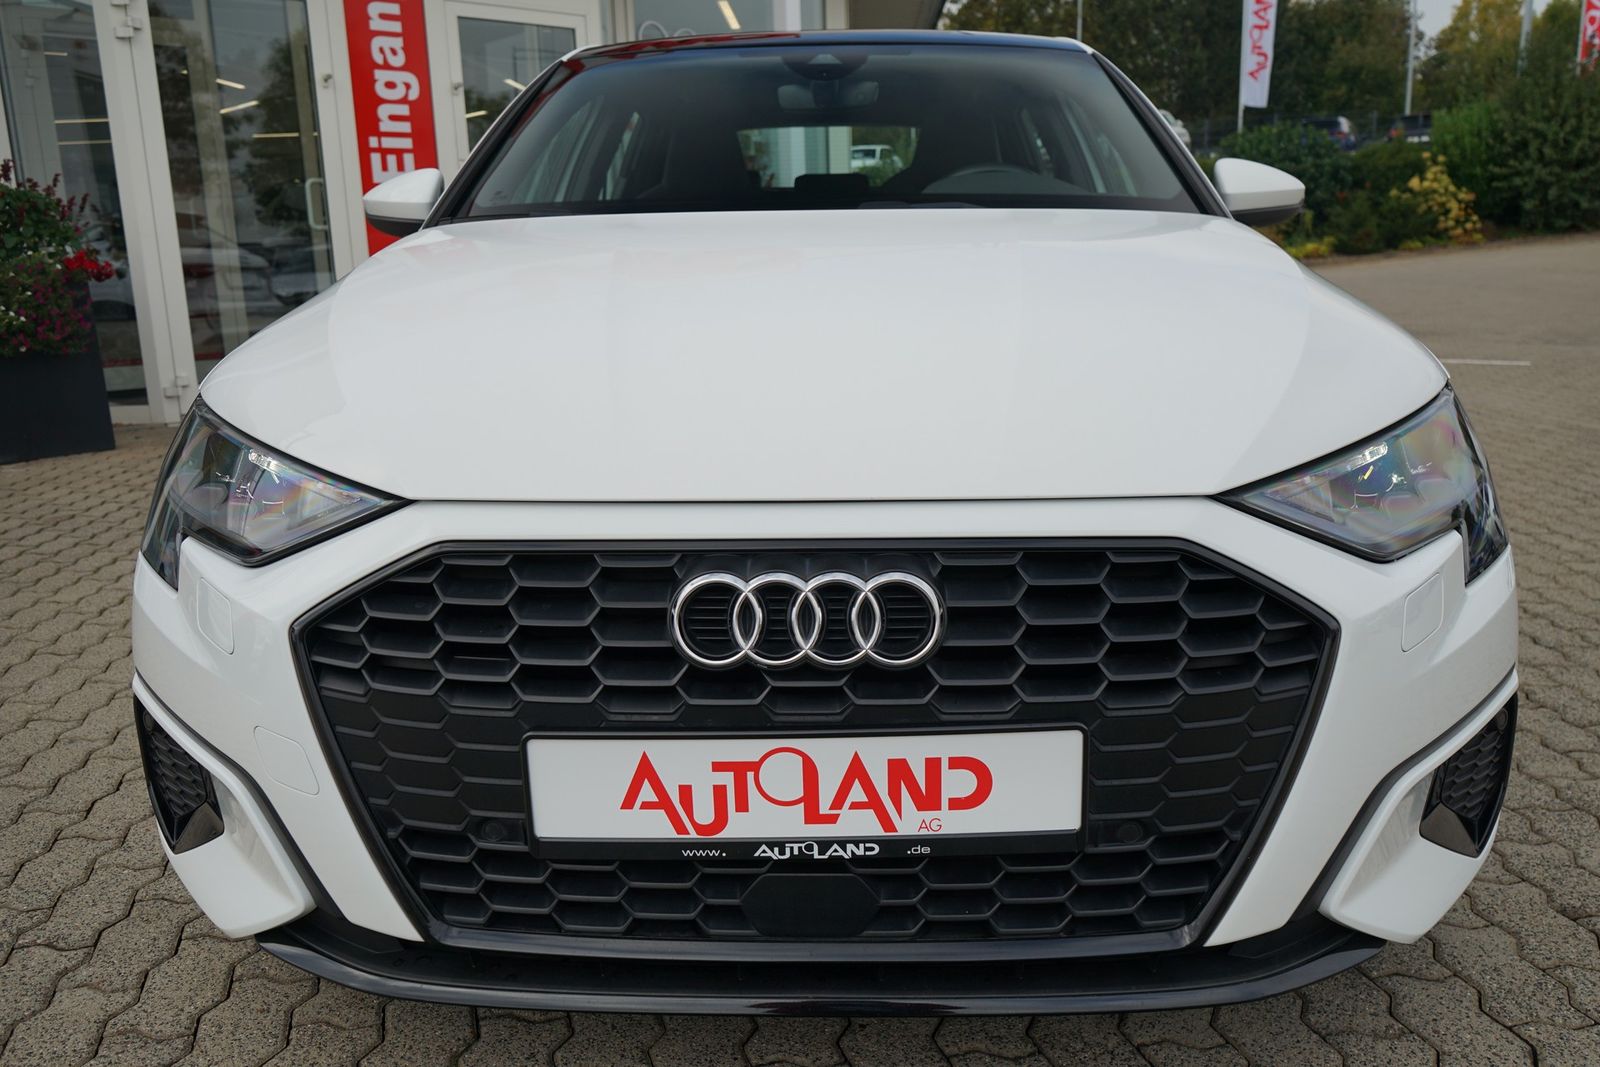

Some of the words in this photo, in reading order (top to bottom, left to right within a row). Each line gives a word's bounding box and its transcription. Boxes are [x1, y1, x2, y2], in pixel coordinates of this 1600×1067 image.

[619, 746, 993, 838] AUTOLAND
[917, 817, 943, 833] AG
[681, 849, 727, 857] www.
[753, 841, 880, 860] AUTOLAND
[906, 844, 931, 855] .de
